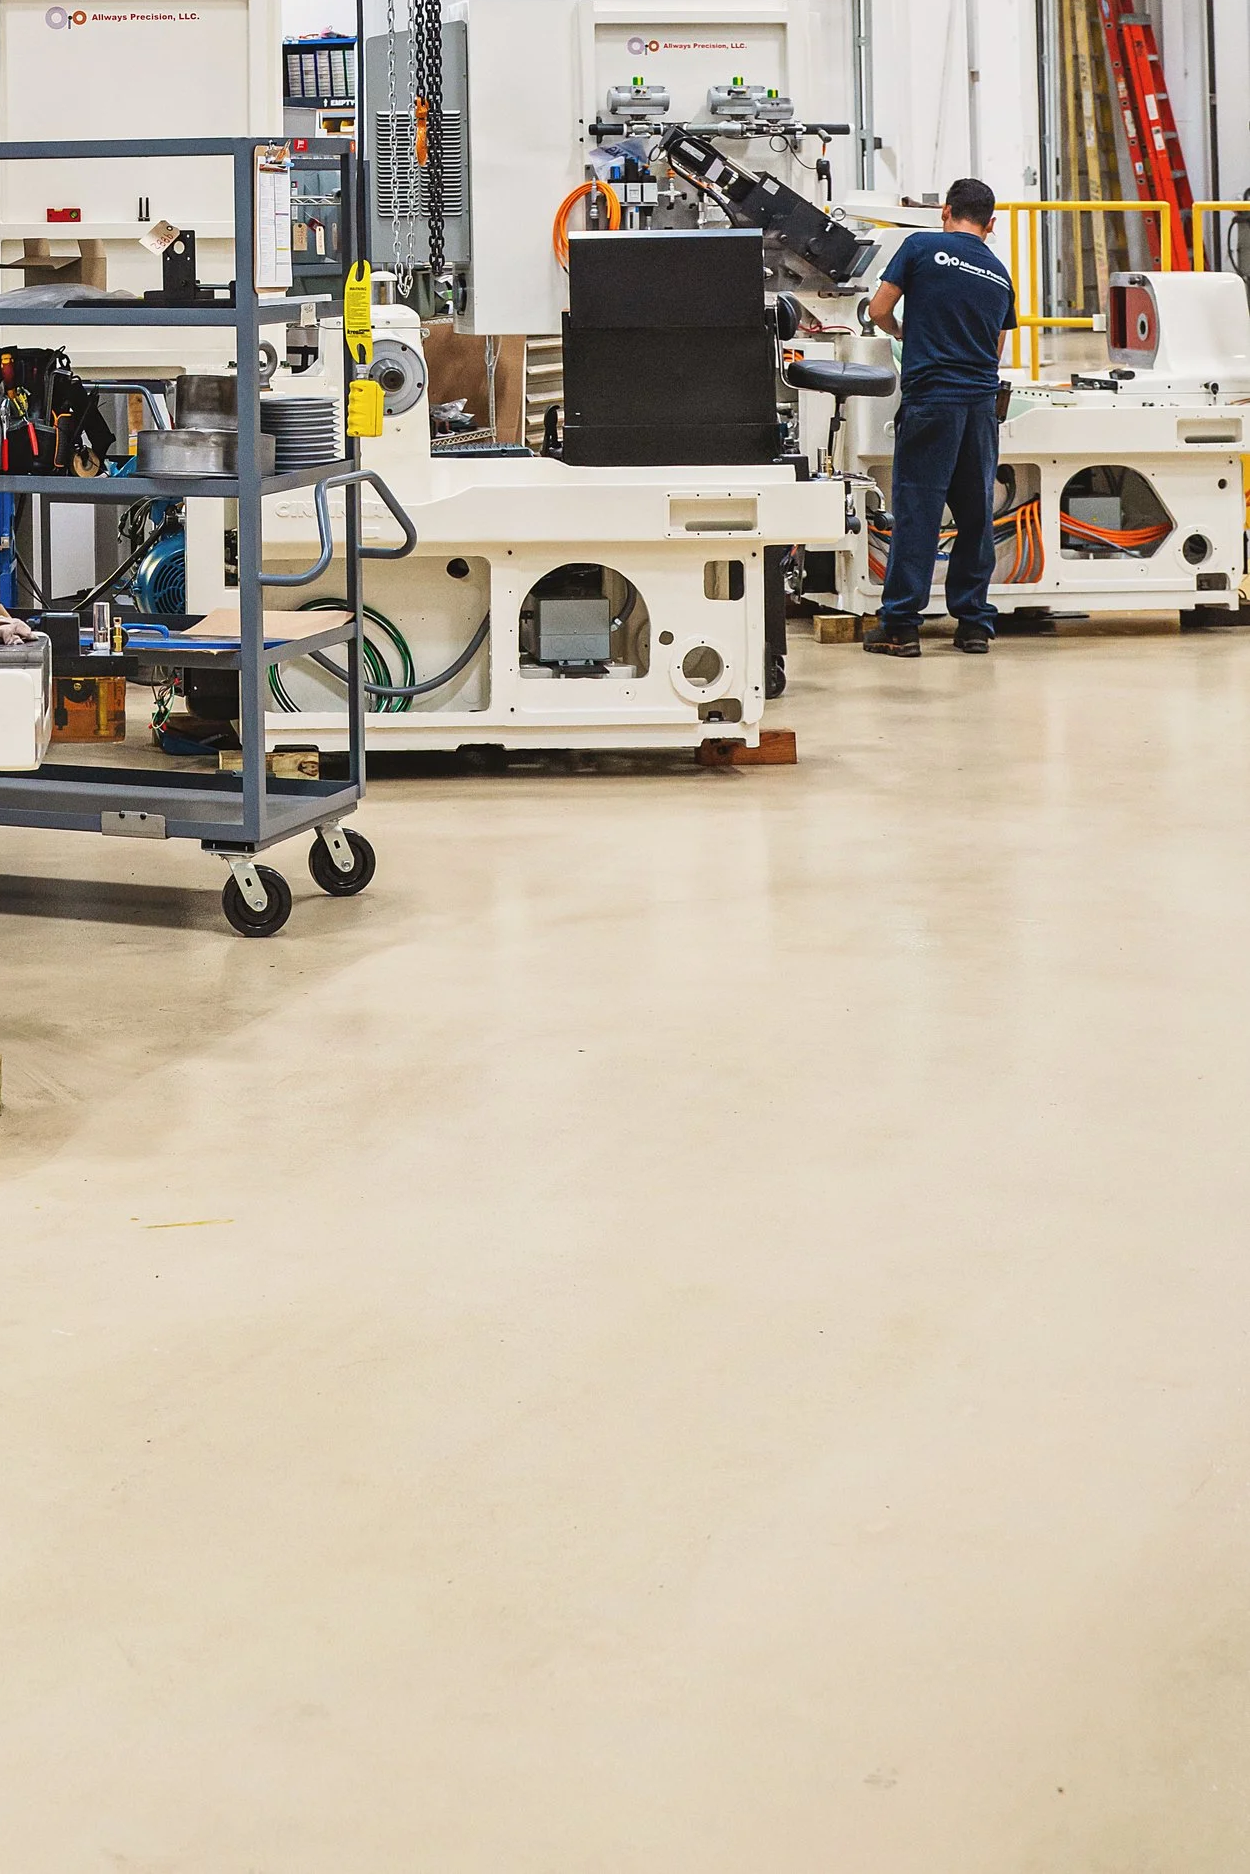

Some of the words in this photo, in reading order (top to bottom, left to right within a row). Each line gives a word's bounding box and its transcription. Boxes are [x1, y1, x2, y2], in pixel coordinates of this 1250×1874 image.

[91, 13, 128, 23] Allways
[130, 13, 176, 22] Precision,
[179, 13, 200, 21] LLC.
